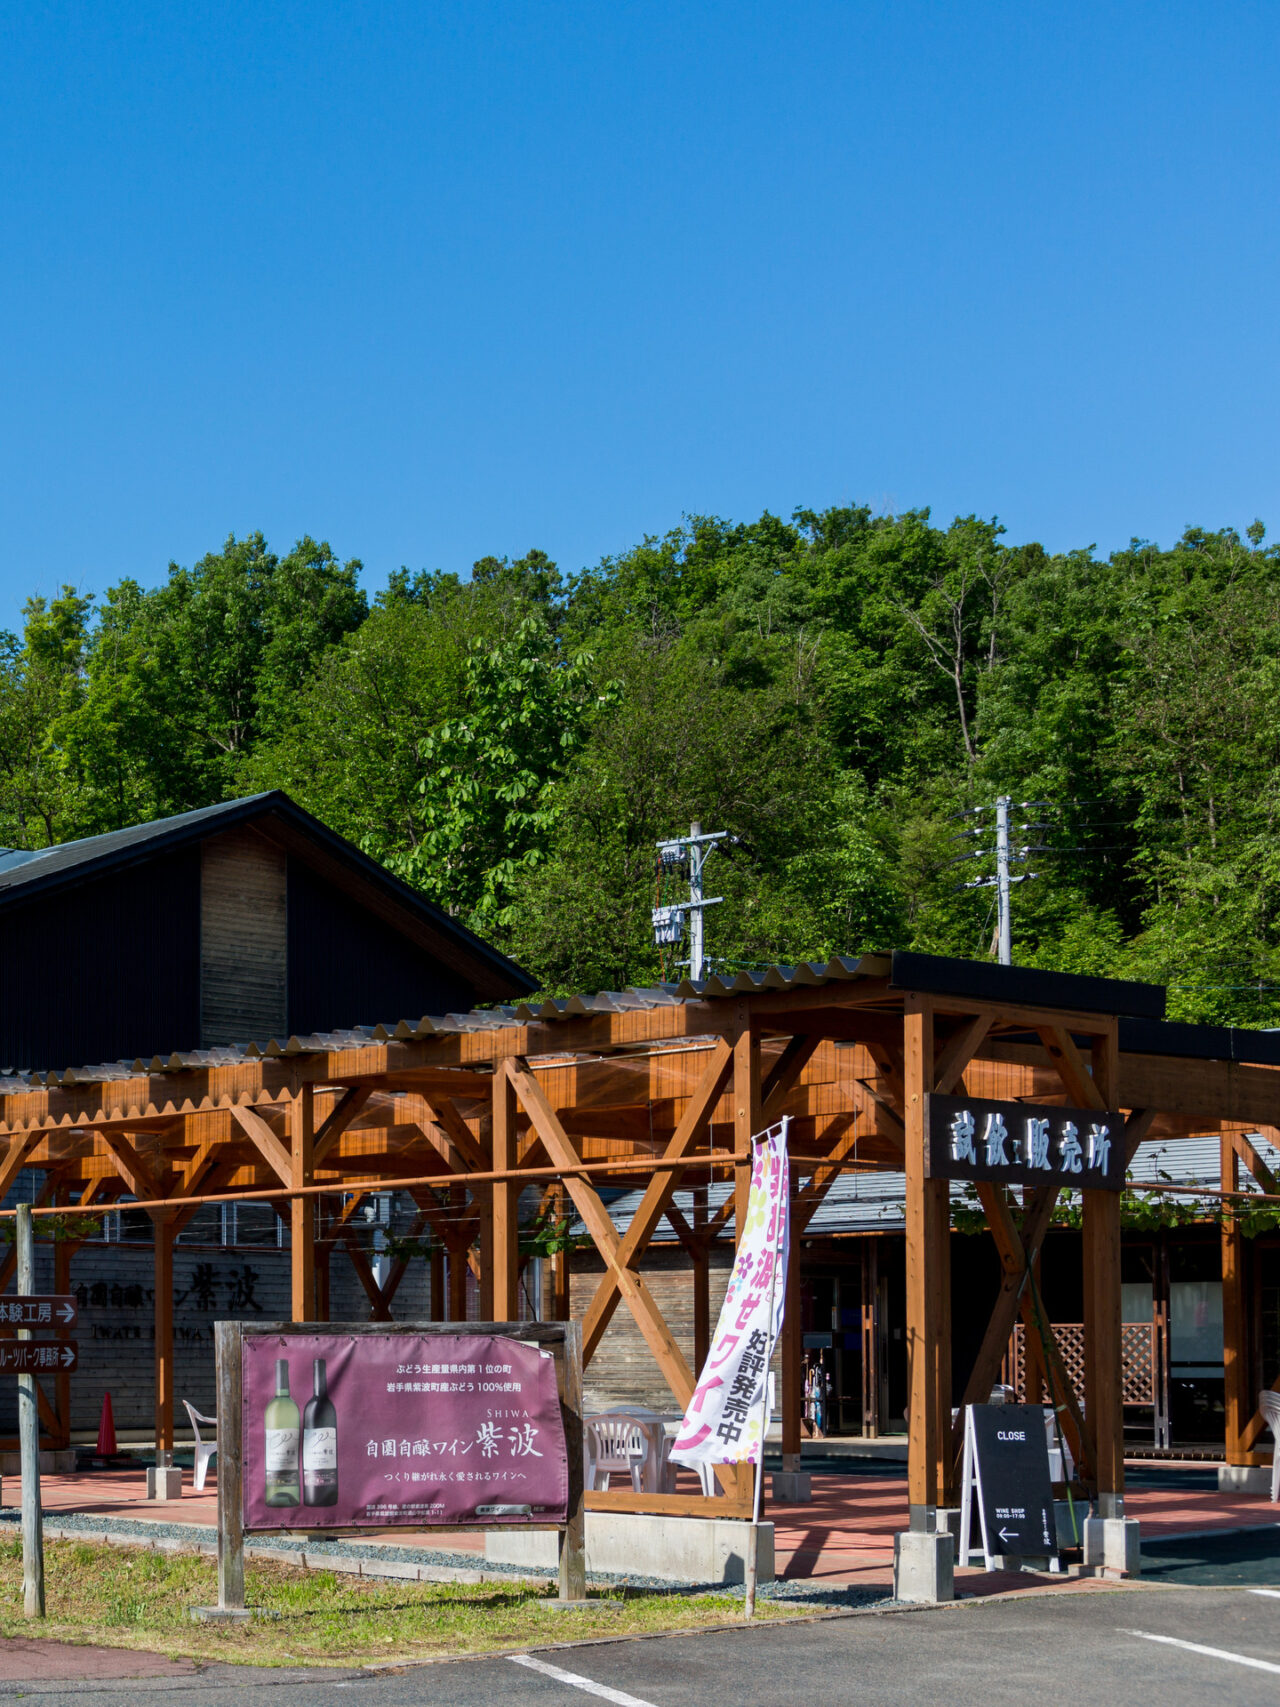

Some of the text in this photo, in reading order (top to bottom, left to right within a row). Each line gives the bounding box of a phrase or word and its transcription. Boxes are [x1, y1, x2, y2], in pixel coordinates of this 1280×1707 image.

[716, 1327, 774, 1446] 好評発売中
[487, 1408, 529, 1418] SHIWA
[997, 1431, 1026, 1440] CLOSE
